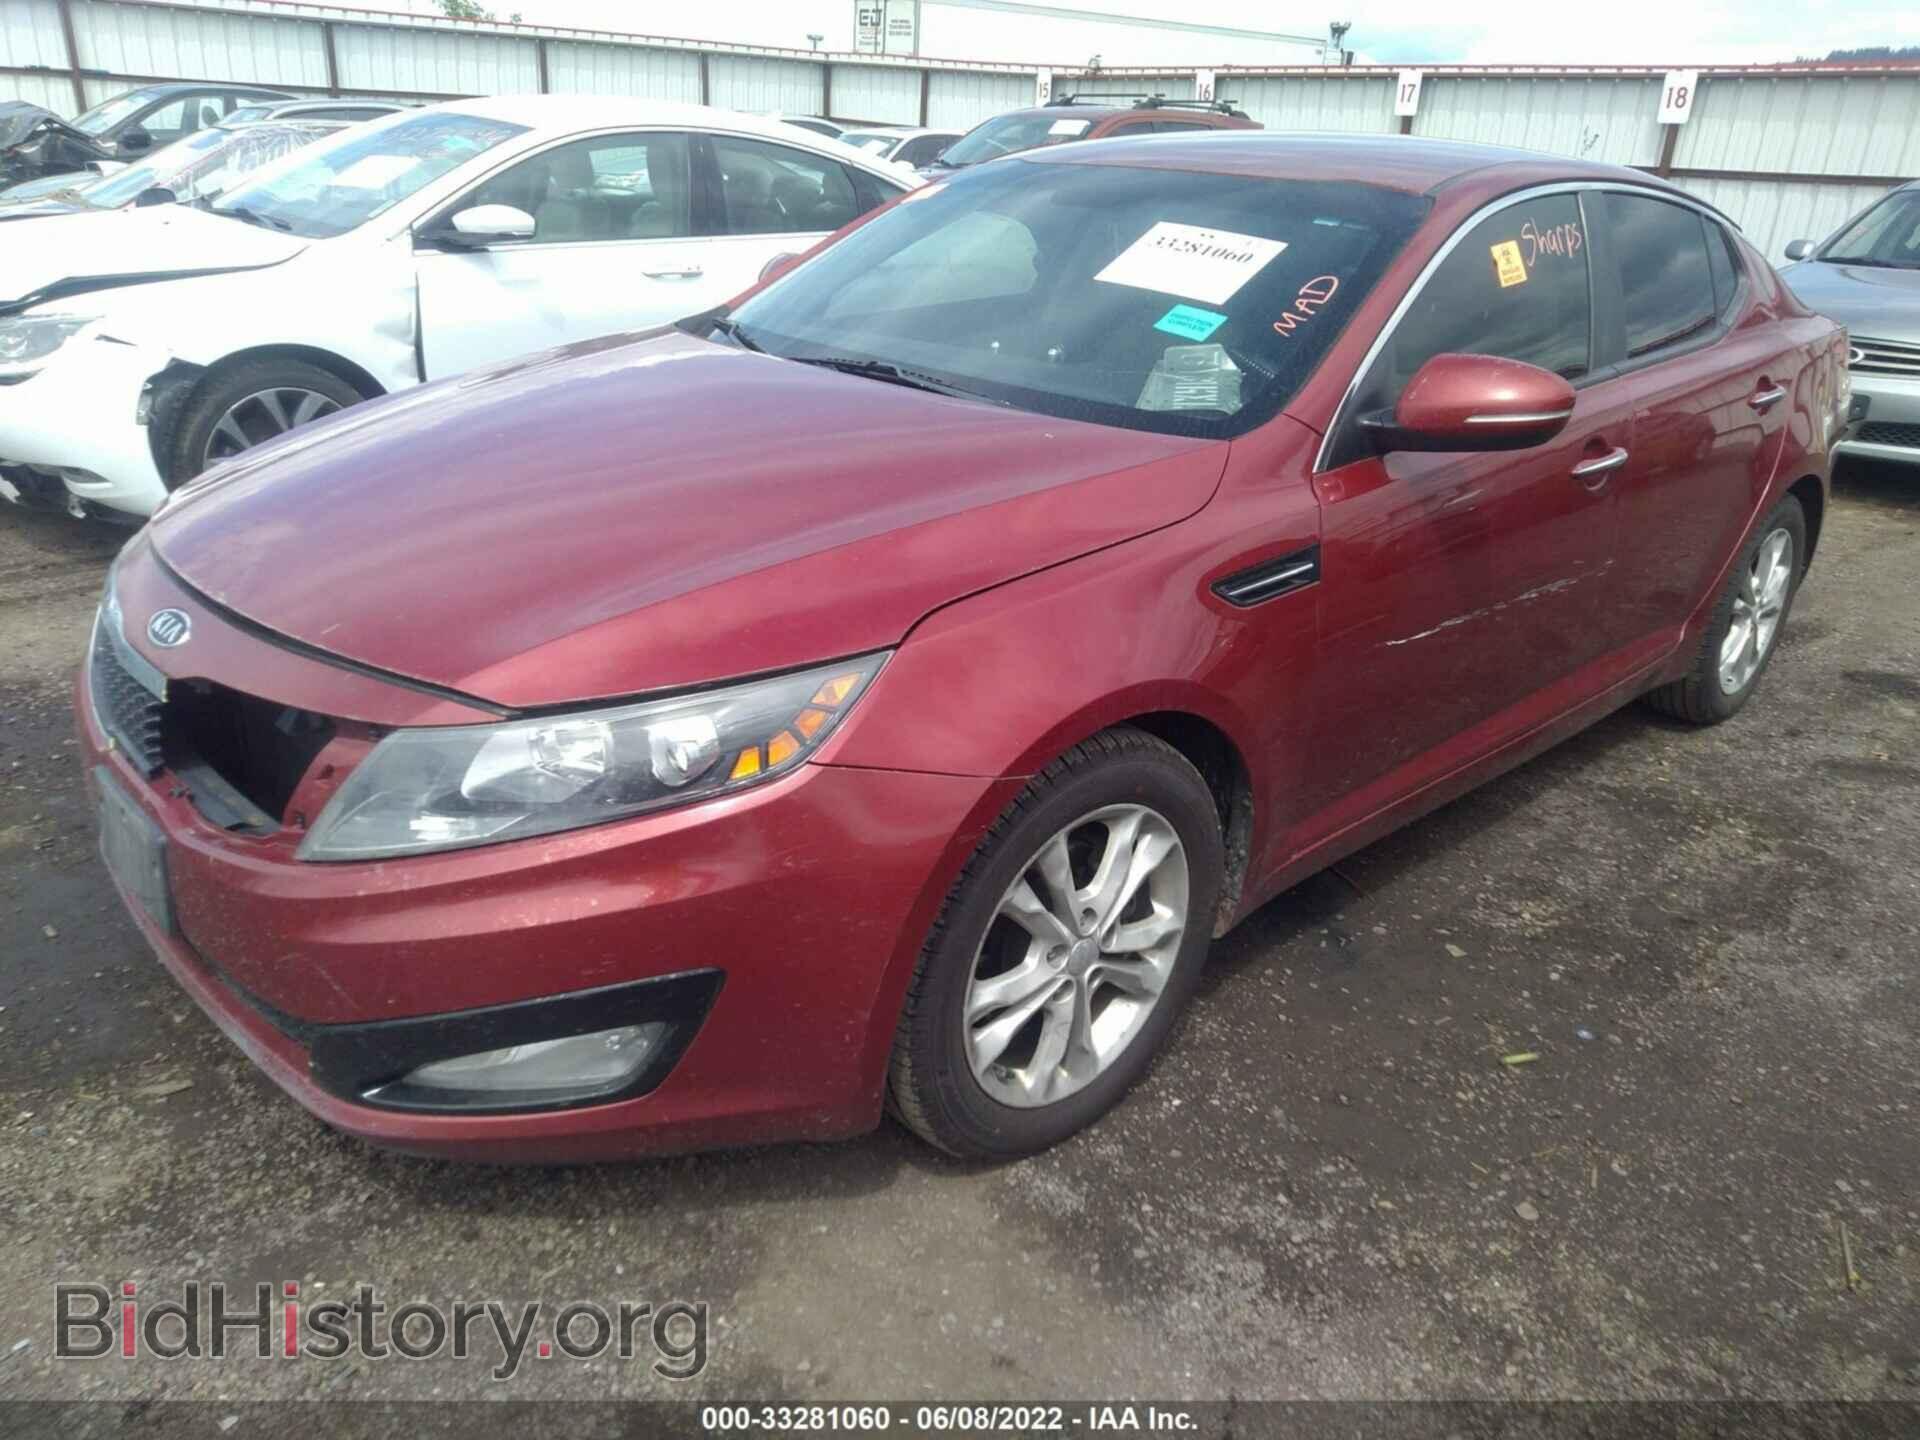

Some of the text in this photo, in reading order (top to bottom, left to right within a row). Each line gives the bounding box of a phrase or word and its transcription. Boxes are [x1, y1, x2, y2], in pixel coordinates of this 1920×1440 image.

[1039, 82, 1049, 99] 15
[1199, 83, 1211, 100] 16
[1400, 83, 1417, 103] 17
[1666, 86, 1688, 109] 18
[1521, 216, 1582, 267] Sharps
[1272, 275, 1339, 337] MAD
[151, 612, 183, 643] KIA
